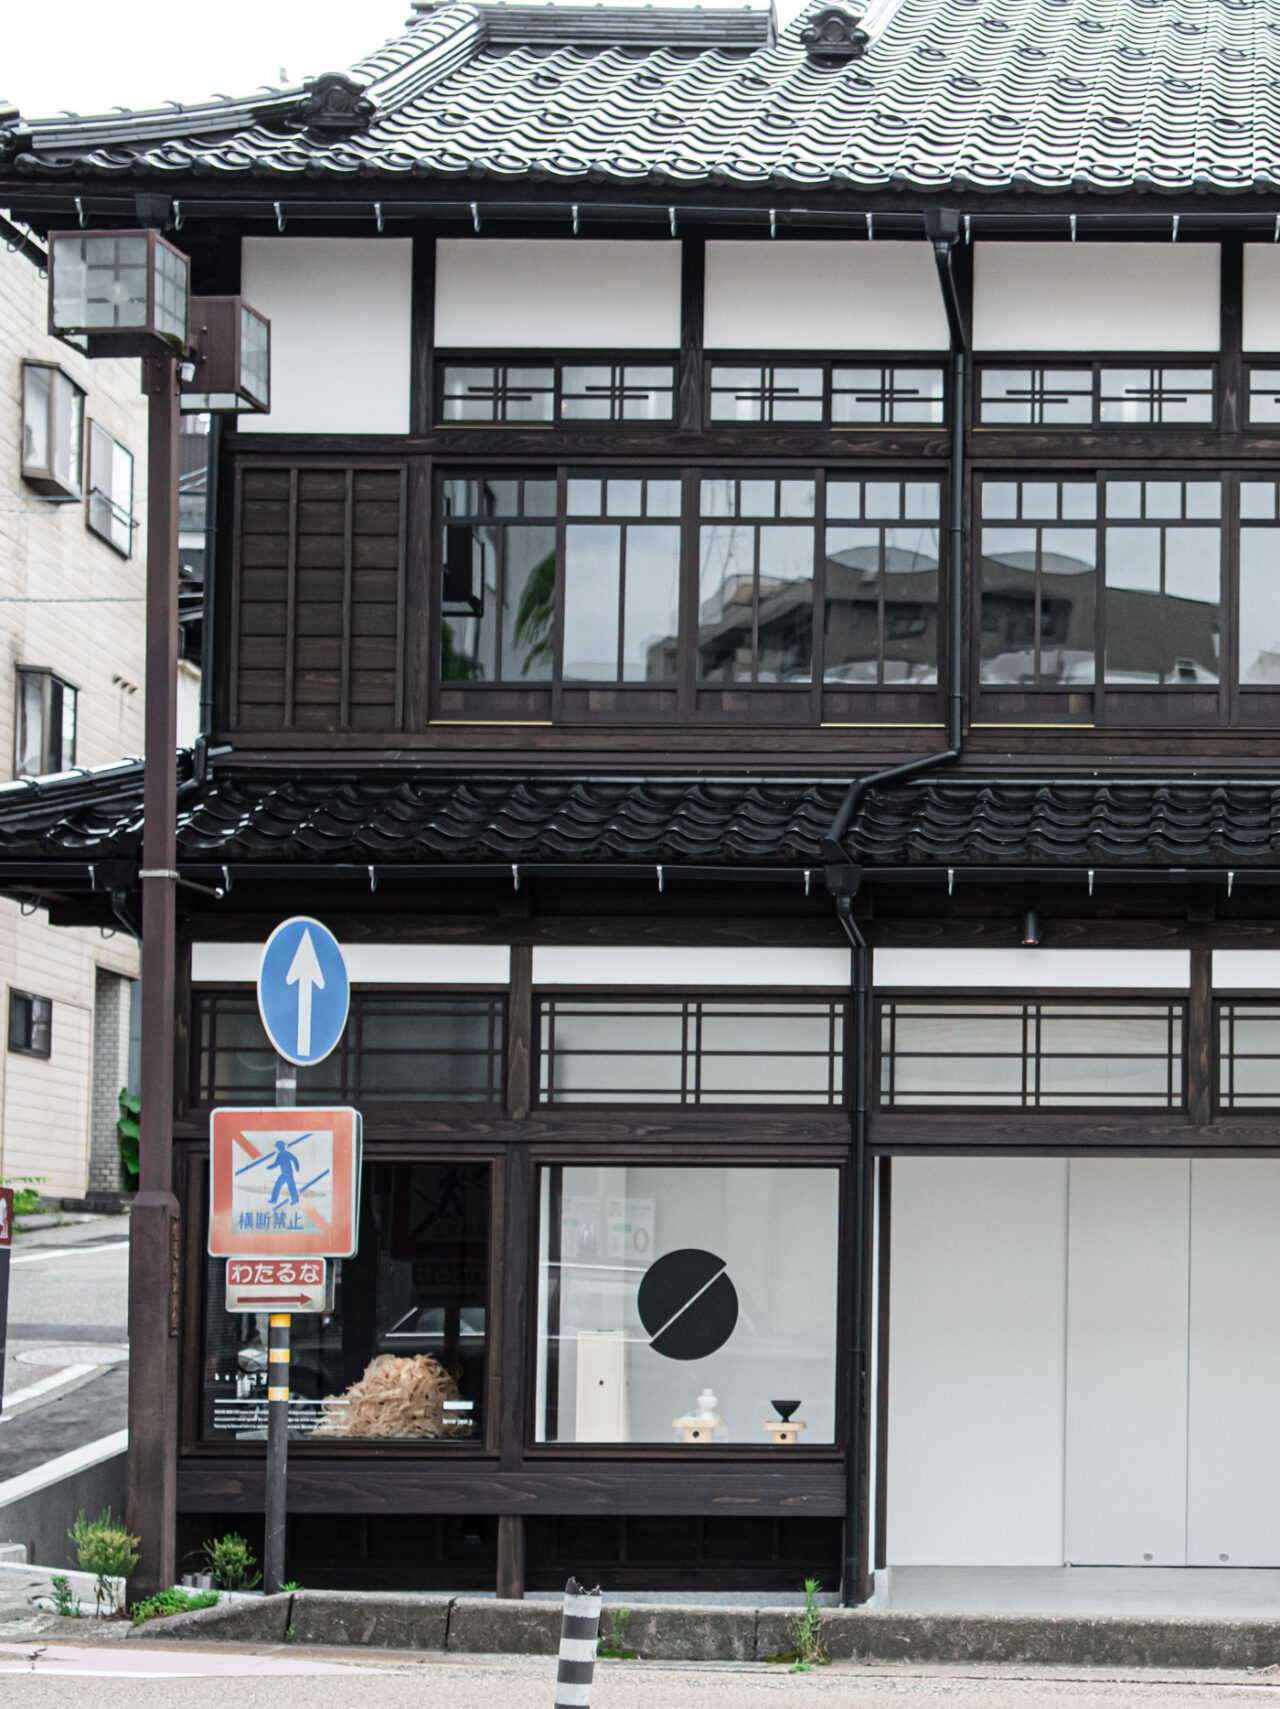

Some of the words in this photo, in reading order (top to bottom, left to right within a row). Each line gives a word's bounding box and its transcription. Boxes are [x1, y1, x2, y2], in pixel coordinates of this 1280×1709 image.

[238, 1211, 304, 1230] 横断禁止
[232, 1263, 320, 1283] わたるな
